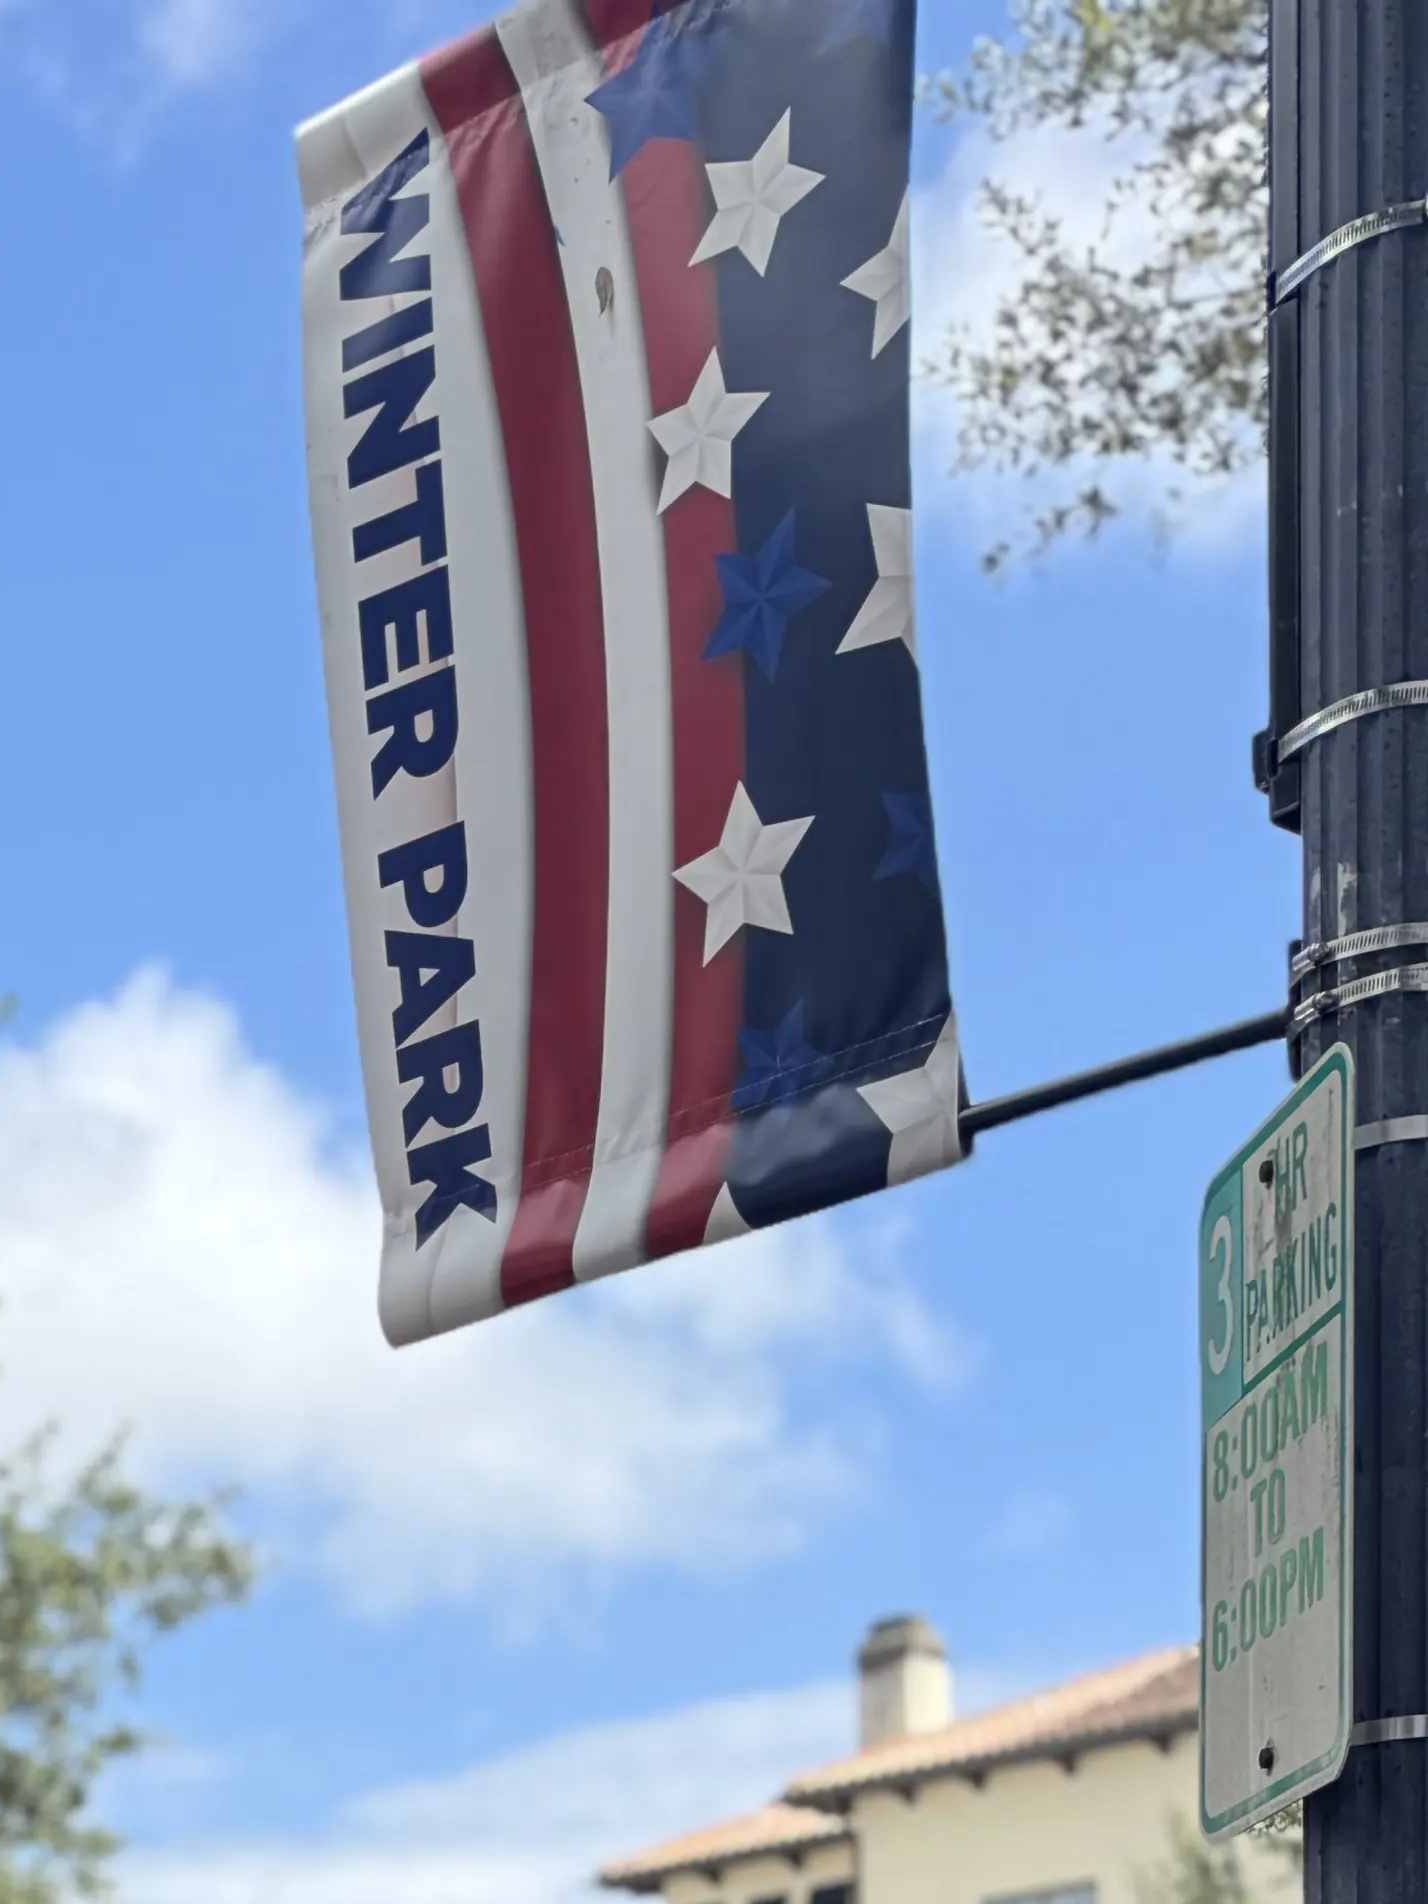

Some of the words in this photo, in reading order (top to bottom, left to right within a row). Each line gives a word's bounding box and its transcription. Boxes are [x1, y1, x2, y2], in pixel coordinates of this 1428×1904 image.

[338, 126, 460, 801] WINTER
[377, 820, 498, 1253] PARK
[1274, 1121, 1309, 1218] HR
[1207, 1214, 1235, 1376] 3
[1245, 1202, 1338, 1363] PARKING
[1212, 1340, 1328, 1502] 8:00AM
[1250, 1467, 1286, 1557] TO
[1211, 1526, 1324, 1673] 6:00PM
